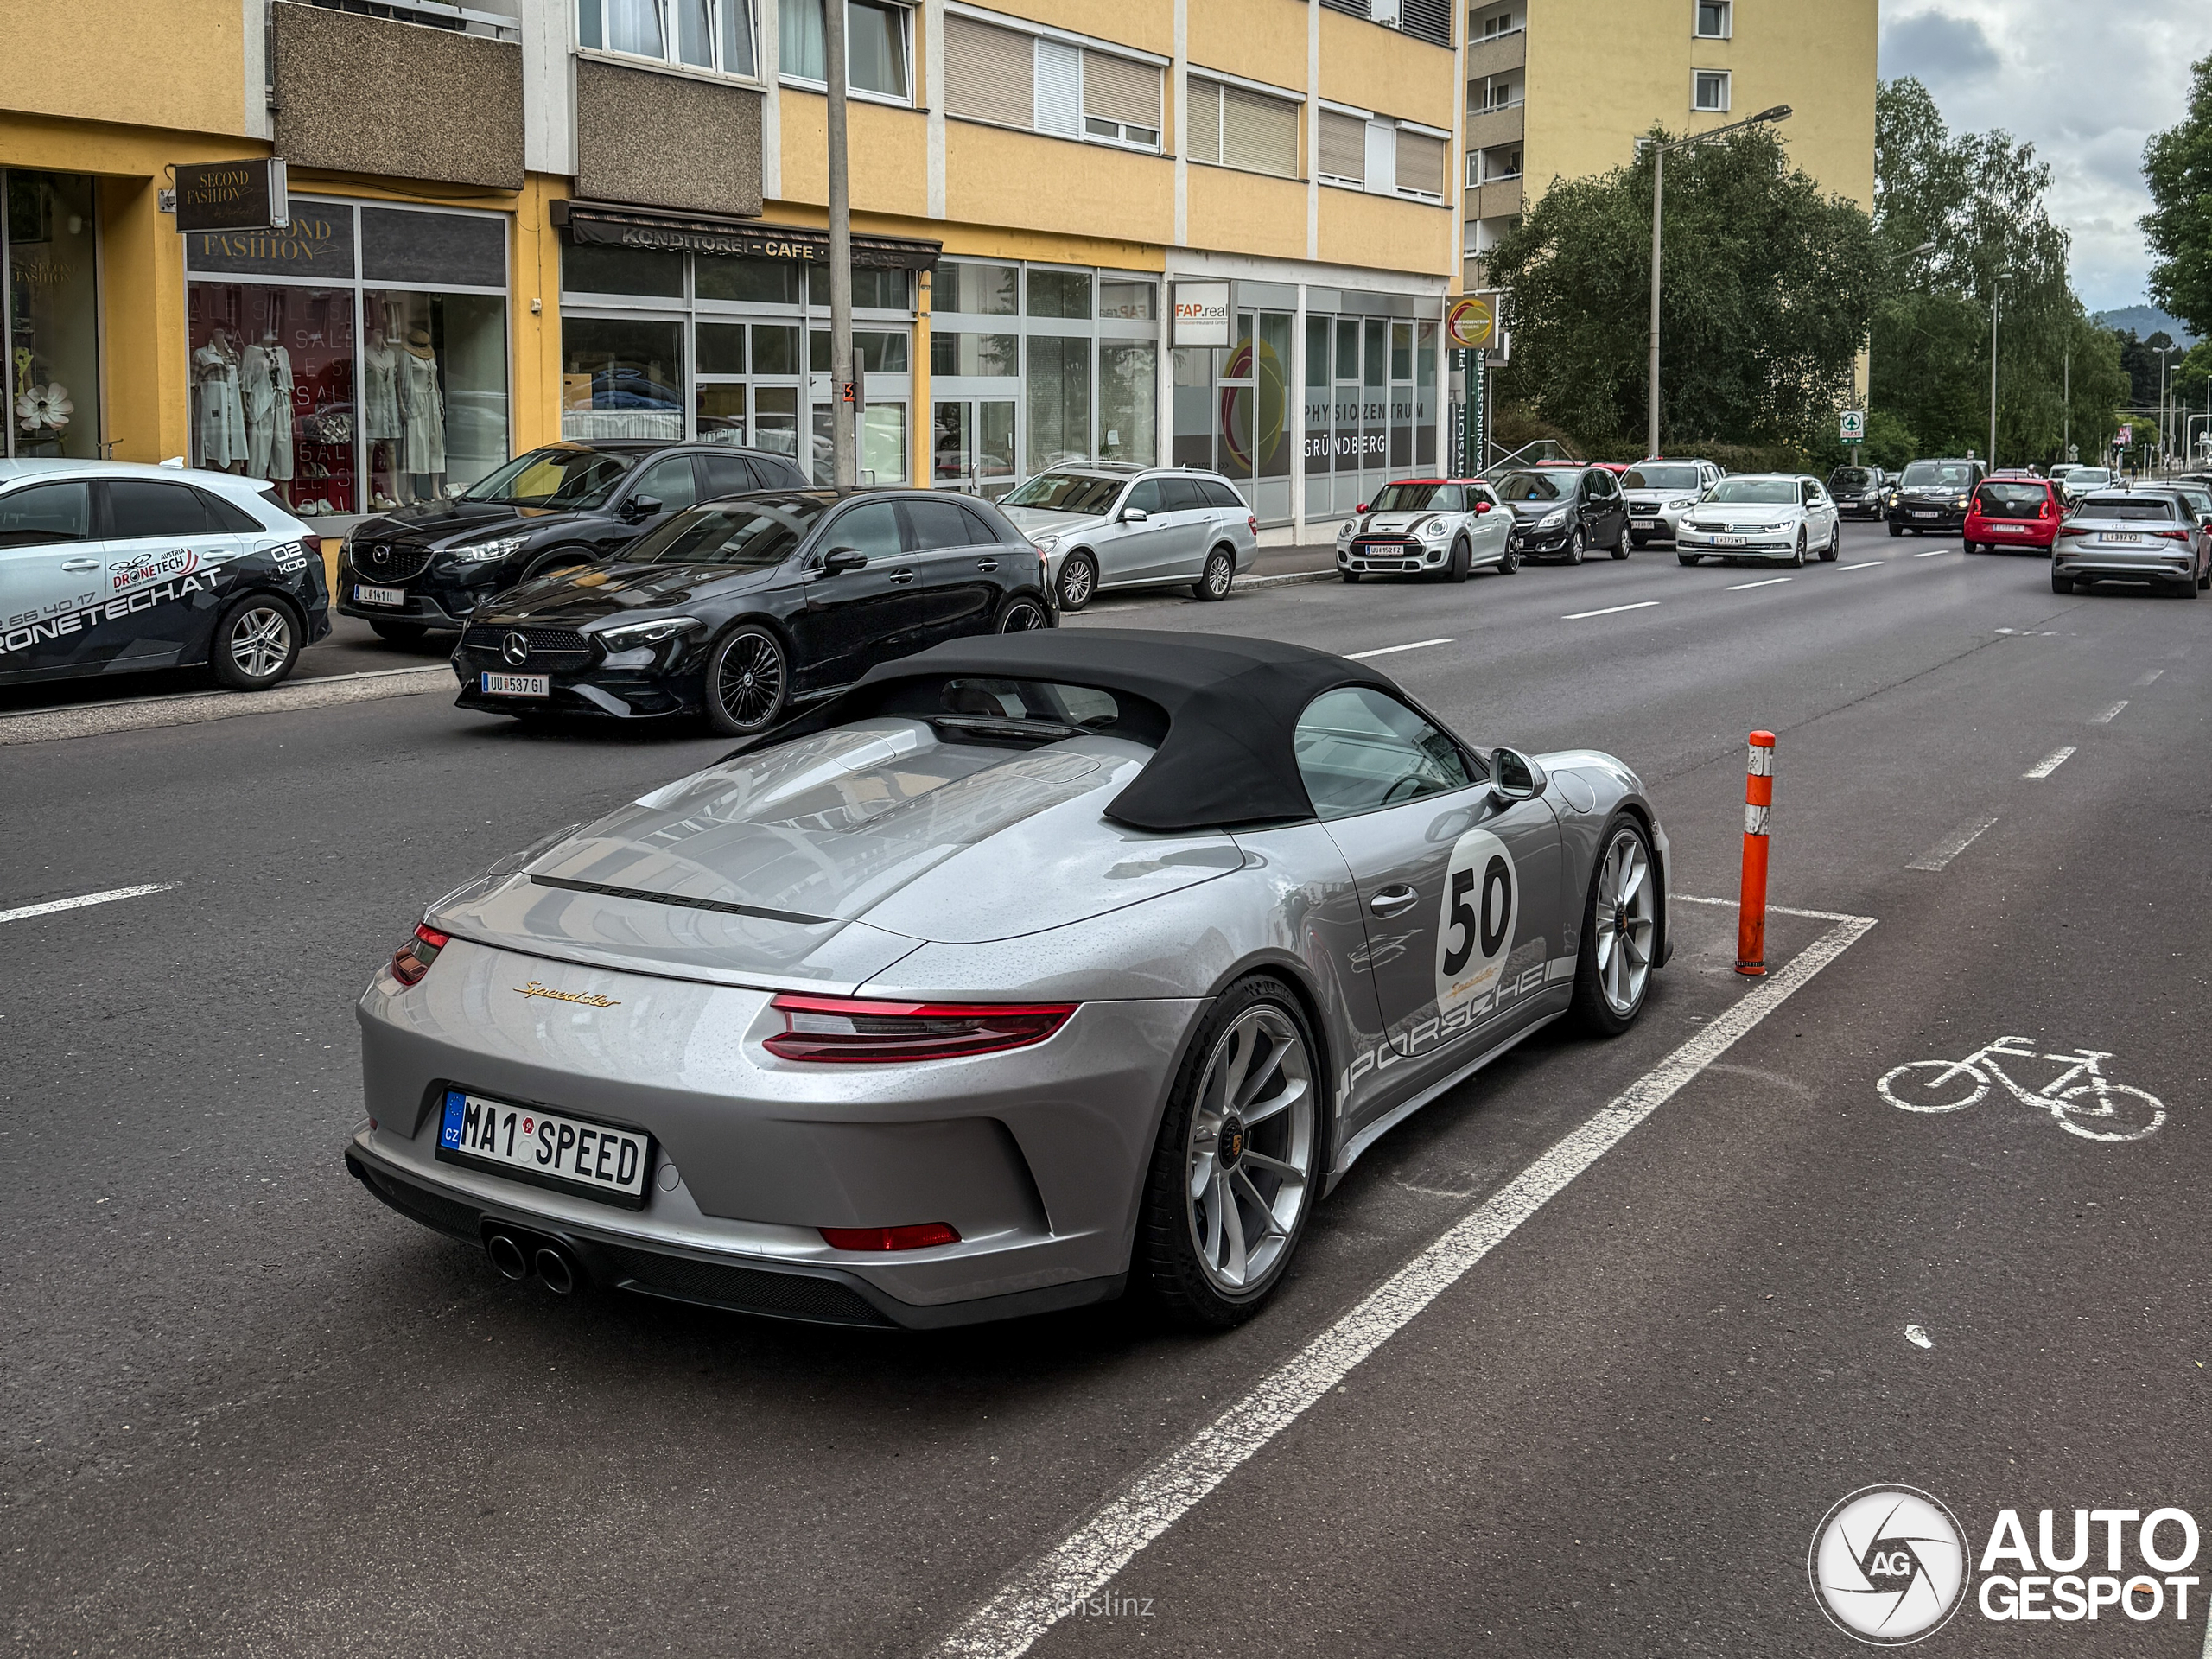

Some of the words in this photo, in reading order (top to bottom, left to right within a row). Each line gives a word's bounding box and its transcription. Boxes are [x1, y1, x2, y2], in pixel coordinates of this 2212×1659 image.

[200, 170, 249, 188] SECOND
[188, 188, 240, 205] FASHION
[204, 235, 313, 260] FASHION
[623, 227, 748, 253] KONDITOREI
[766, 241, 814, 259] CAFE
[1176, 303, 1228, 317] FAP.real
[1305, 402, 1424, 423] PHYSIOZENTRUM
[1304, 434, 1385, 457] GRÜNDBERG
[161, 547, 186, 561] AUSTRIA
[270, 542, 303, 562] 02
[113, 555, 185, 588] DRONETECH
[277, 557, 308, 575] KDO
[364, 588, 368, 599] L
[387, 591, 394, 601] IL
[9, 610, 38, 626] 66
[43, 600, 73, 614] 40
[77, 591, 96, 605] 17
[491, 676, 502, 690] UU
[510, 678, 529, 692] 537
[531, 679, 543, 693] GI
[585, 885, 741, 913] PORSCHE
[1442, 855, 1511, 976] 50
[512, 980, 621, 1007] Speedster
[1349, 962, 1546, 1090] PORSCHE
[445, 1128, 459, 1143] CZ
[461, 1101, 518, 1158] MA1
[535, 1119, 639, 1186] SPEED
